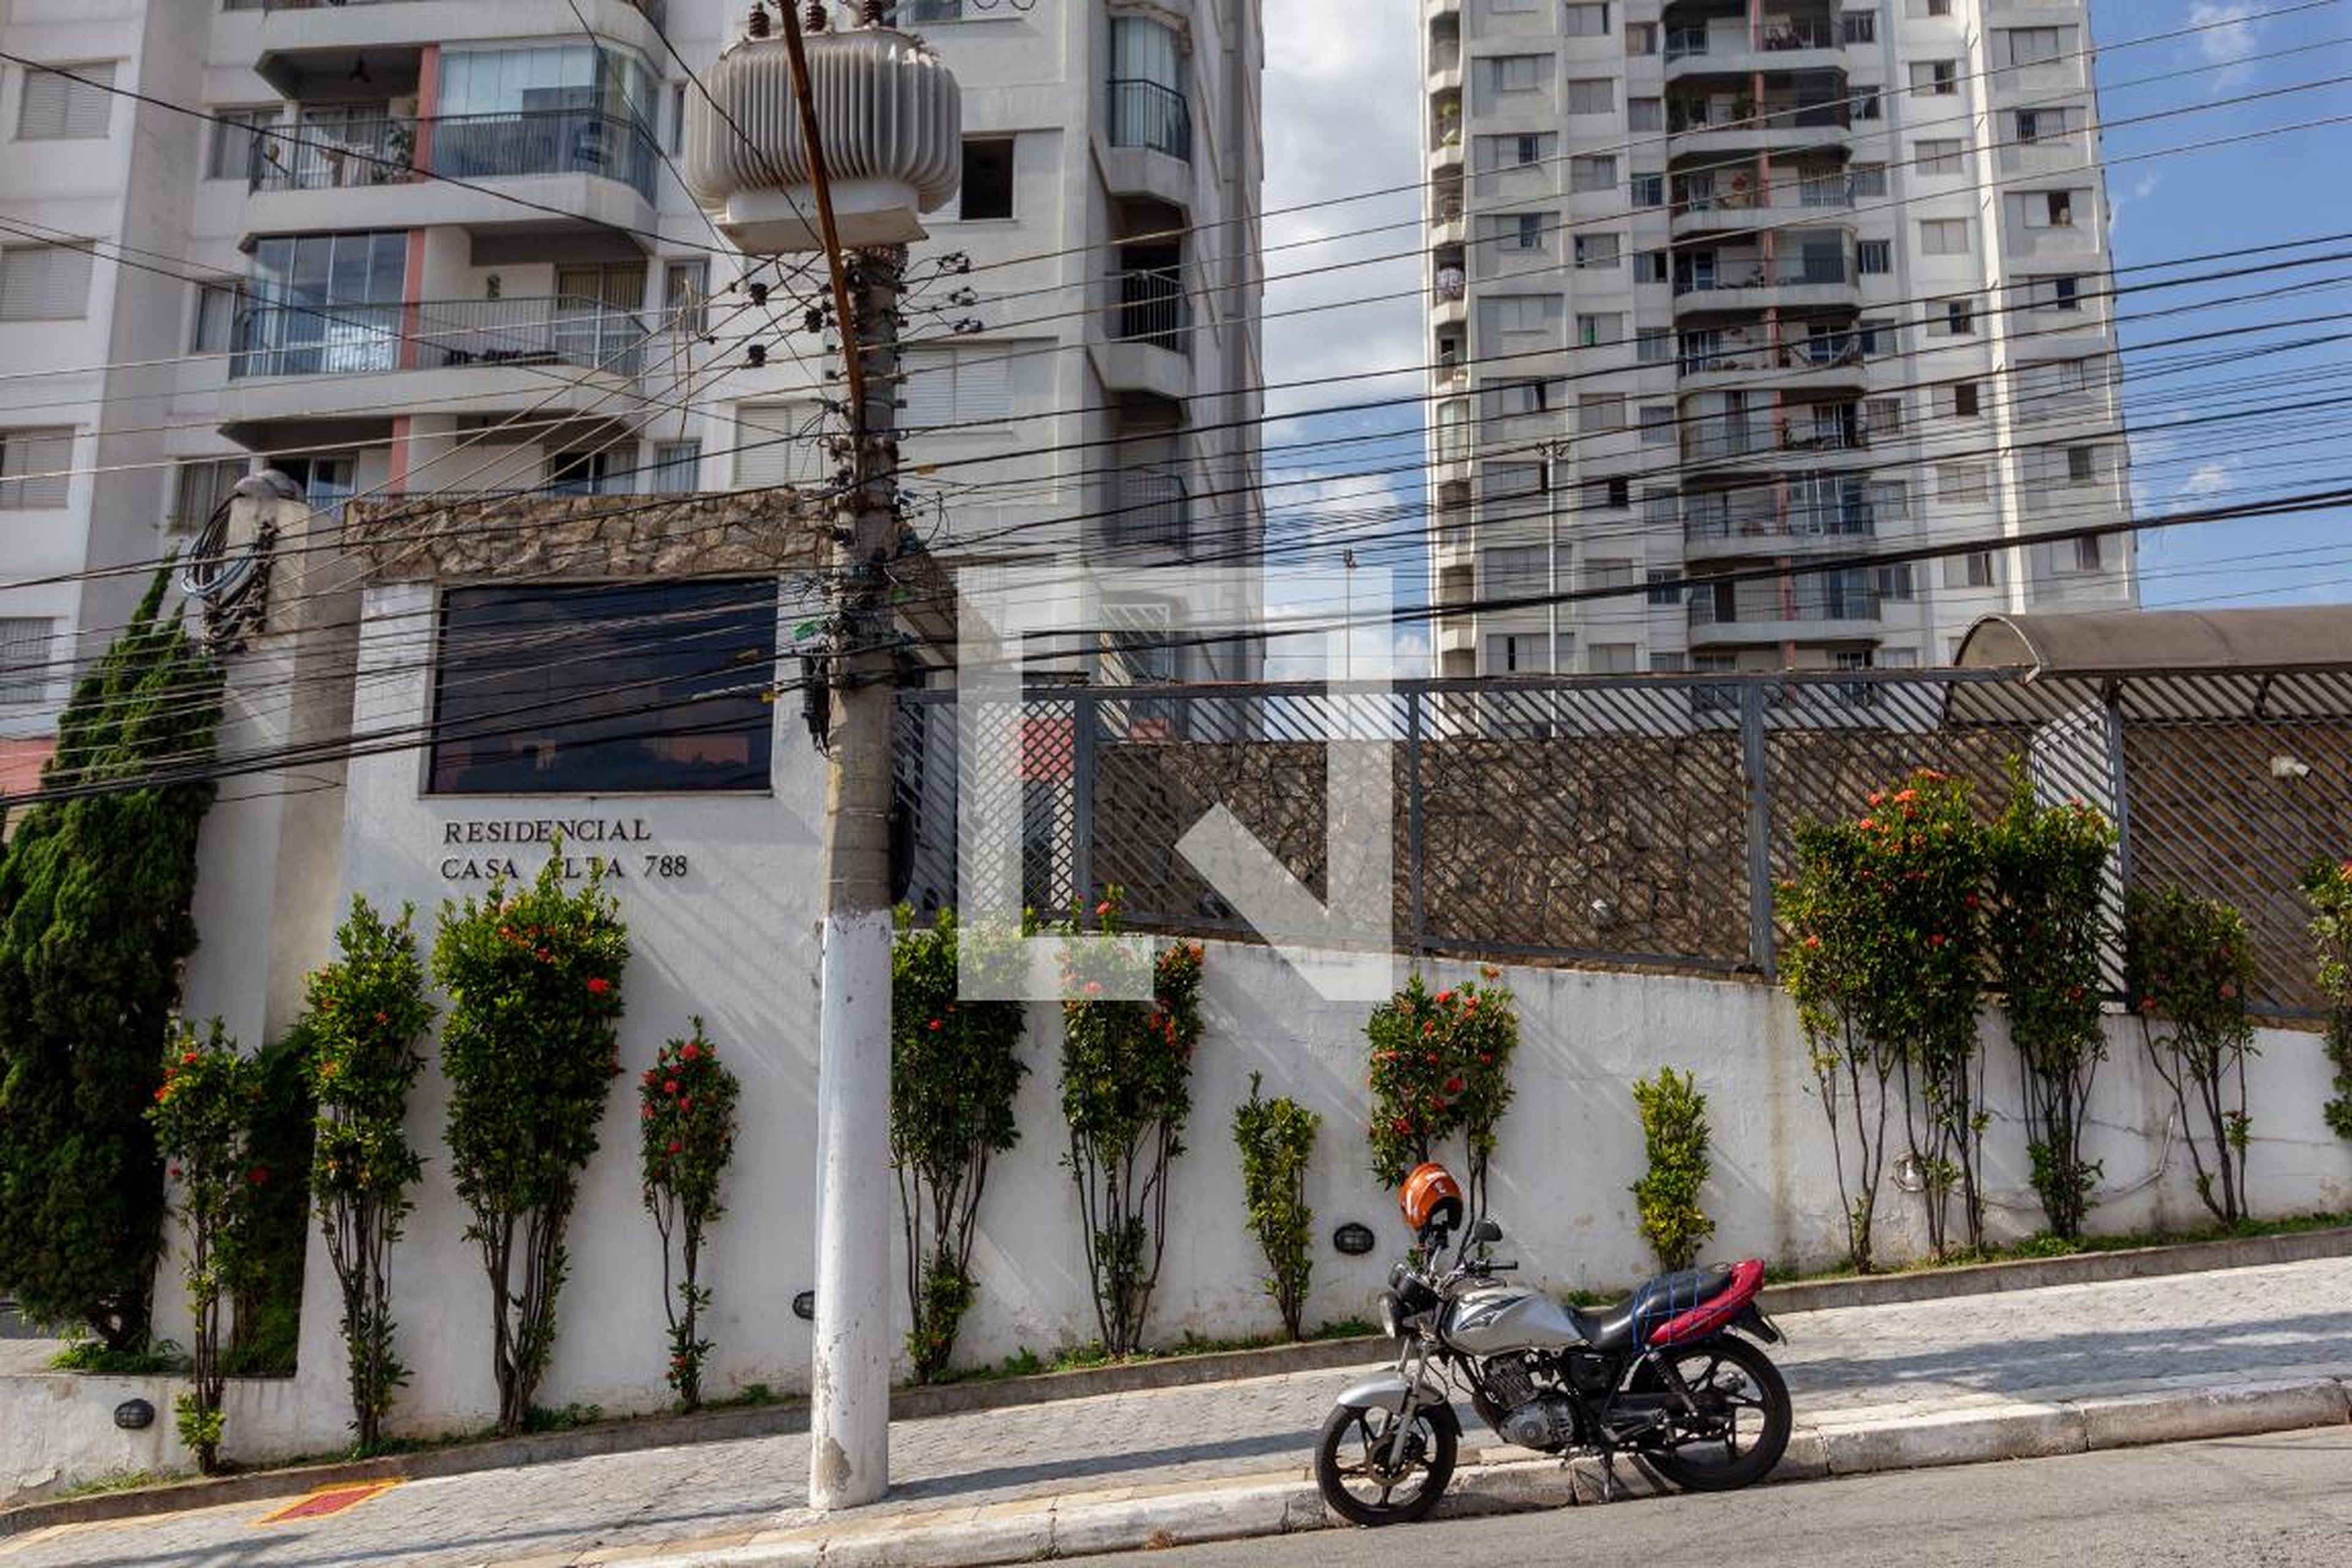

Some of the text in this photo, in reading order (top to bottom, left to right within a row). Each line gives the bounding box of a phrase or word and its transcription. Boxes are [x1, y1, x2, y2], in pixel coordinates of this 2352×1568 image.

[443, 819, 652, 843] RESIDENCIAL
[441, 858, 518, 879] CASA
[644, 855, 687, 878] 788
